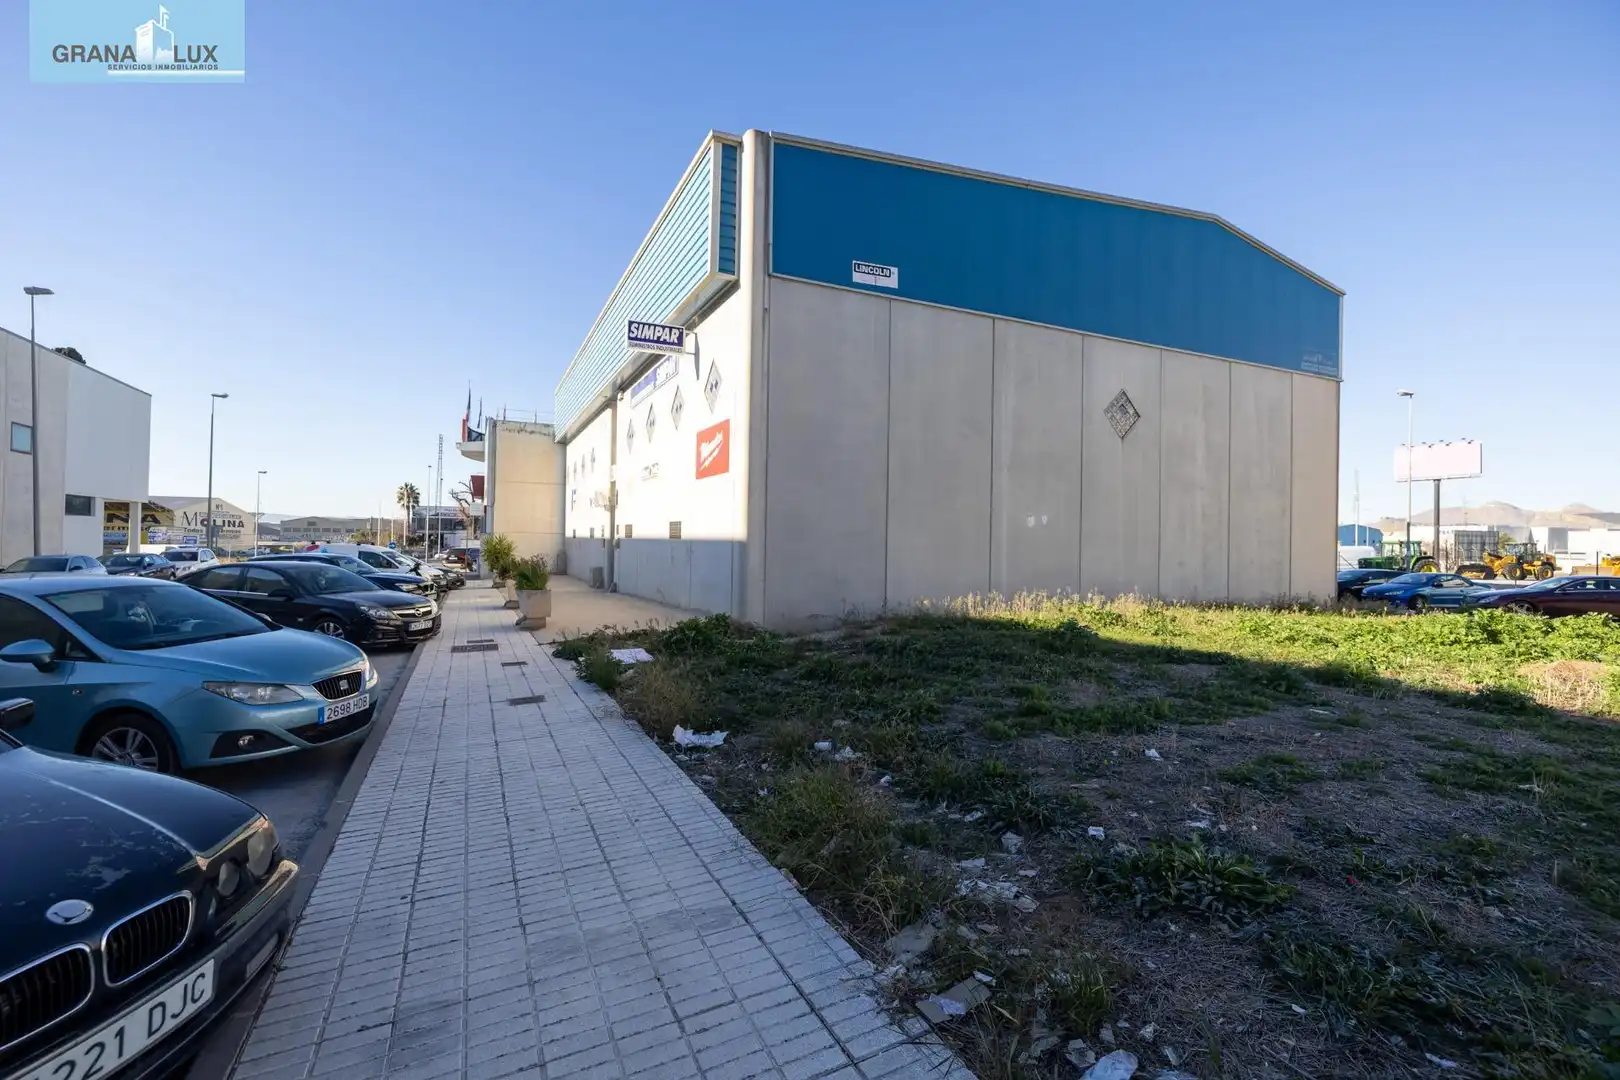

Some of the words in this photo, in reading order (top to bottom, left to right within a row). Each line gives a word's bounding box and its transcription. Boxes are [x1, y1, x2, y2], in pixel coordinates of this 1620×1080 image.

[855, 263, 891, 277] LINCOLN
[630, 322, 680, 343] SIMPAR
[326, 702, 351, 720] 2698
[34, 1025, 126, 1080] 221
[147, 972, 206, 1040] DJC
